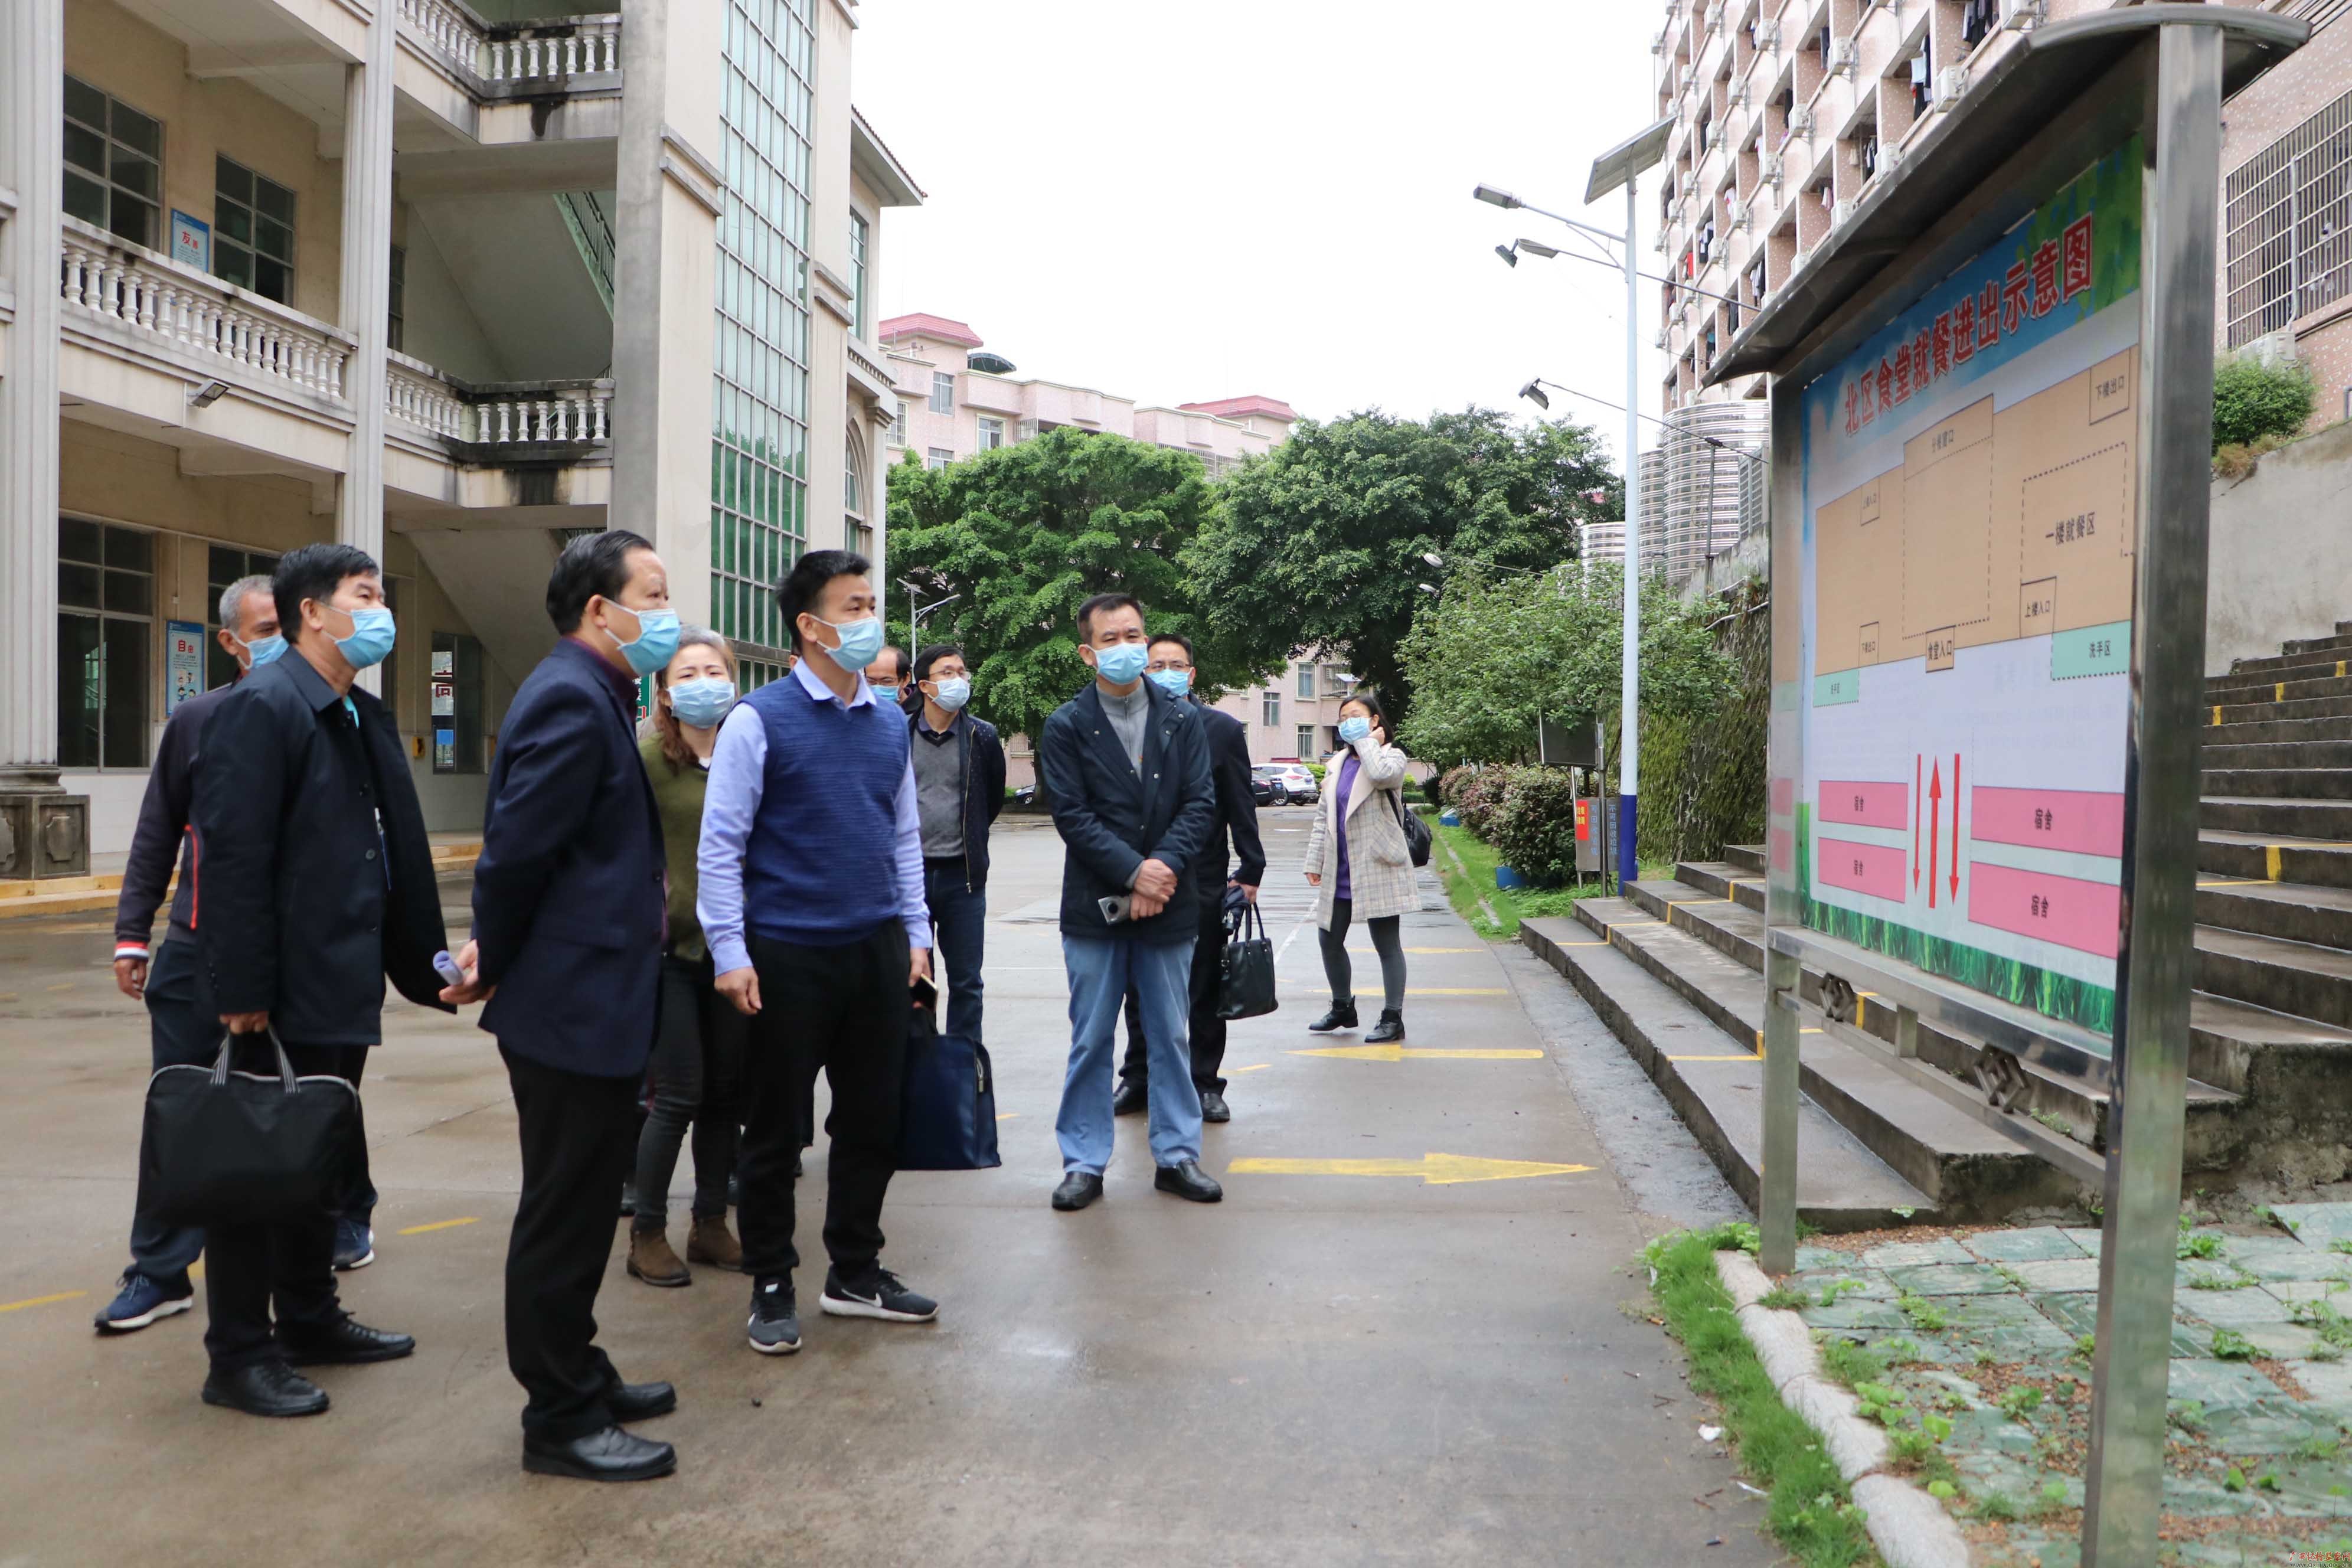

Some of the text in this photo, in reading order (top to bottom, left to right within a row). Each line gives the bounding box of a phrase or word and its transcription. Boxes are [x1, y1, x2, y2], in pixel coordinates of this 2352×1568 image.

[1845, 211, 2093, 436] 北区食堂就餐进出示意图
[2045, 512, 2096, 545] 一楼就餐区
[2024, 600, 2050, 618] 上楼入口
[1927, 640, 1952, 661] 食堂入口
[2089, 640, 2111, 659] 洗手区
[2034, 808, 2053, 831] 宿舍
[2031, 894, 2049, 919] 宿舍
